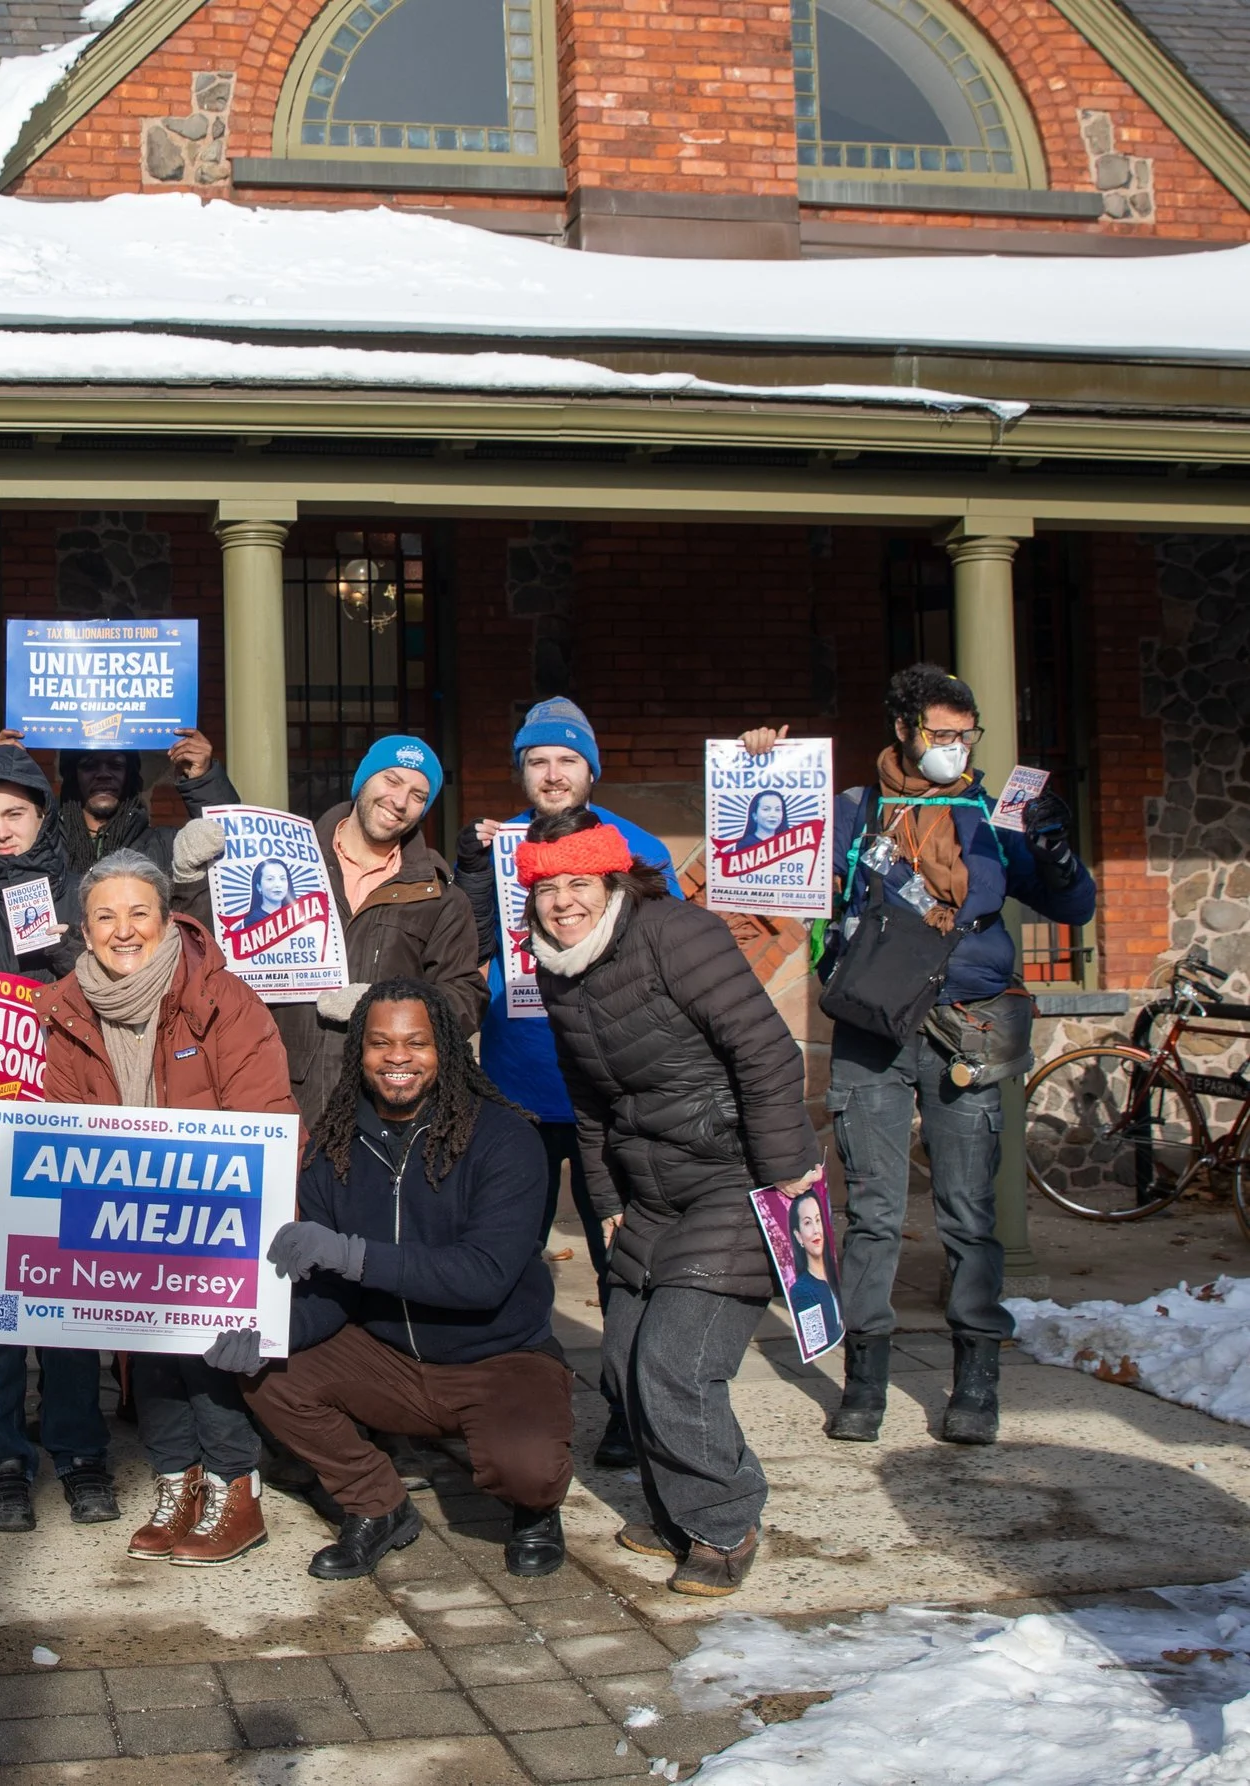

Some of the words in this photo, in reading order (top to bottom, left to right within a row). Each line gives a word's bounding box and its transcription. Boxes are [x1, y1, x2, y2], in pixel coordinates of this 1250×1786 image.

[46, 627, 62, 639] TAX
[64, 627, 121, 640] BILLIONAIRES
[123, 627, 132, 639] TO
[135, 627, 158, 639] FUND
[29, 651, 174, 675] UNIVERSAL
[29, 677, 174, 698] HEALTHCARE
[50, 701, 77, 711] AND
[80, 701, 146, 711] CHILDCARE
[711, 770, 826, 789] UNBOSSED
[214, 837, 319, 864] NBOSSED
[728, 826, 815, 873] ANALILIA
[779, 862, 804, 873] FOR
[739, 874, 804, 886] CONGRESS
[6, 882, 46, 899] UNBOUGHT
[7, 889, 48, 906] UNBOSSED
[750, 890, 774, 898] MEJIA
[9, 904, 20, 912] FOR
[239, 896, 325, 955] ANALILIA
[290, 936, 316, 949] FOR
[252, 950, 317, 965] CONGRESS
[265, 972, 289, 980] MEJIA
[322, 970, 331, 978] OF
[333, 969, 342, 977] US
[513, 988, 541, 996] ANALI
[87, 1117, 173, 1133] UNBOSSED.
[178, 1121, 206, 1135] FOR
[210, 1123, 236, 1136] ALL
[240, 1124, 260, 1137] OF
[264, 1126, 288, 1139] US.
[23, 1145, 251, 1192] ANALILIA
[90, 1201, 246, 1247] MEJIA
[19, 1254, 61, 1285] for
[72, 1258, 143, 1290] New
[150, 1264, 245, 1303] Jersey
[24, 1304, 65, 1319] VOTE
[72, 1307, 159, 1326] THURSDAY,
[165, 1312, 244, 1328] FEBRUARY
[248, 1316, 257, 1329] 5
